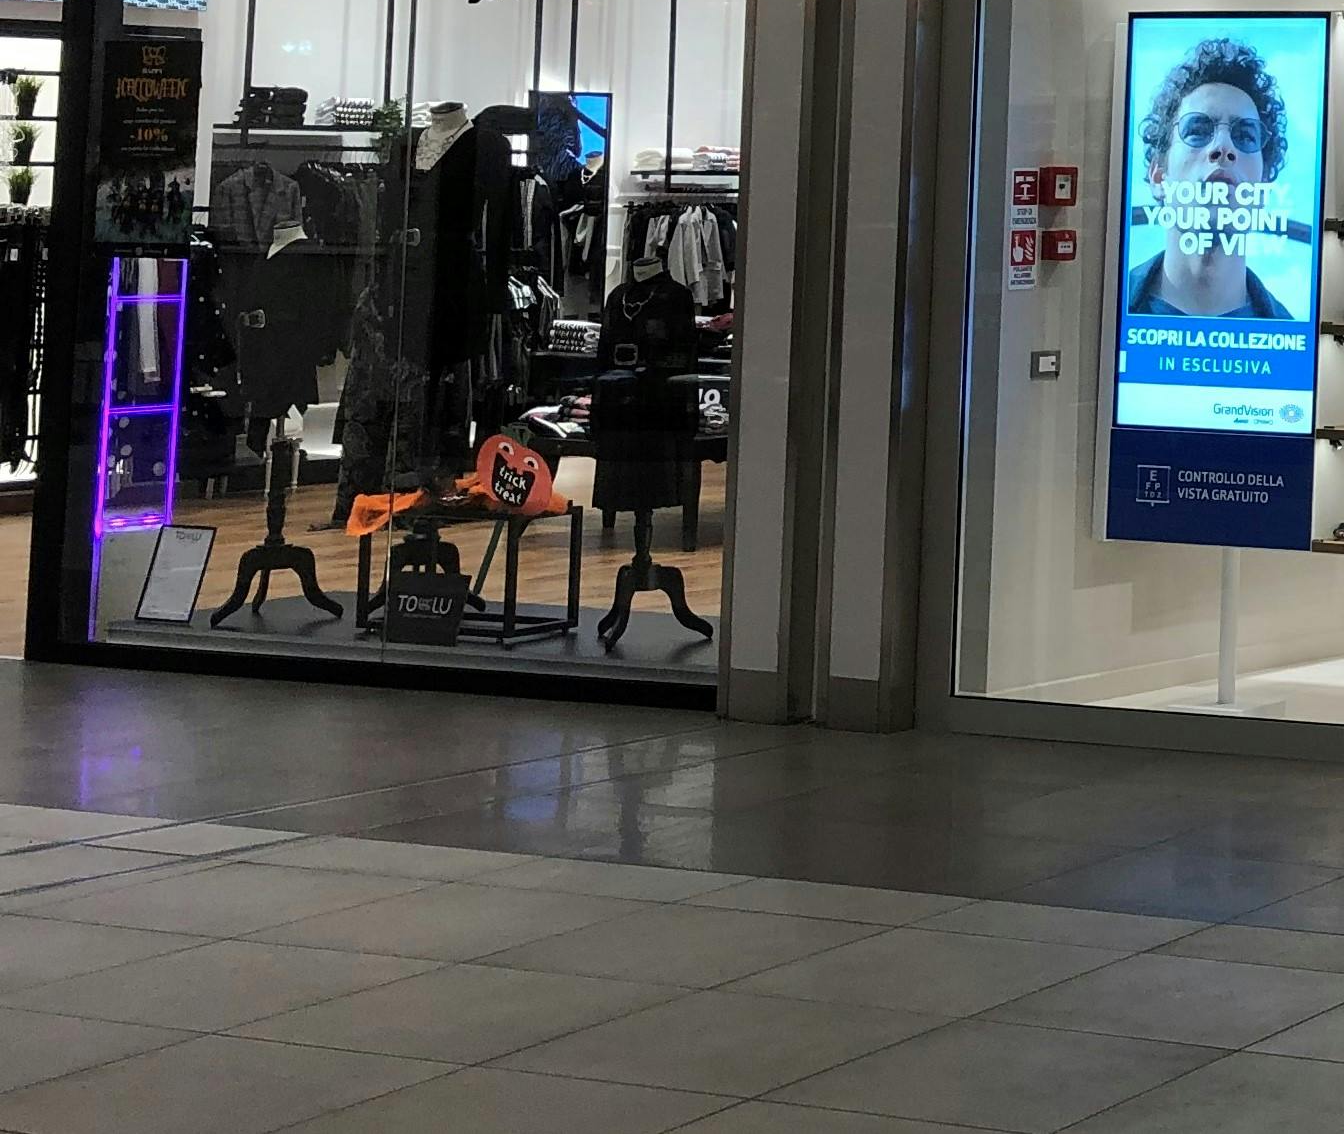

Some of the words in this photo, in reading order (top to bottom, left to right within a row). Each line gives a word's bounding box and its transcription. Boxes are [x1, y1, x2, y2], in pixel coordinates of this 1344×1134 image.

[130, 128, 168, 142] -10%
[1162, 181, 1229, 205] YOUR
[1143, 207, 1211, 230] YOUR
[1217, 208, 1289, 232] POINT
[1179, 232, 1213, 255] OF
[1127, 328, 1183, 346] SCOPRI
[1185, 331, 1206, 347] LA
[1209, 332, 1306, 351] COLLEZIONE
[1159, 357, 1176, 371] IN
[1182, 358, 1272, 375] ESCLUSIVA
[1213, 403, 1274, 417] GrandVision
[500, 465, 526, 490] trick
[1178, 470, 1245, 485] CONTROLLO
[1247, 474, 1284, 487] DELLA
[495, 480, 522, 504] treat
[1177, 487, 1209, 500] VISTA
[1212, 488, 1269, 503] GRATUITO
